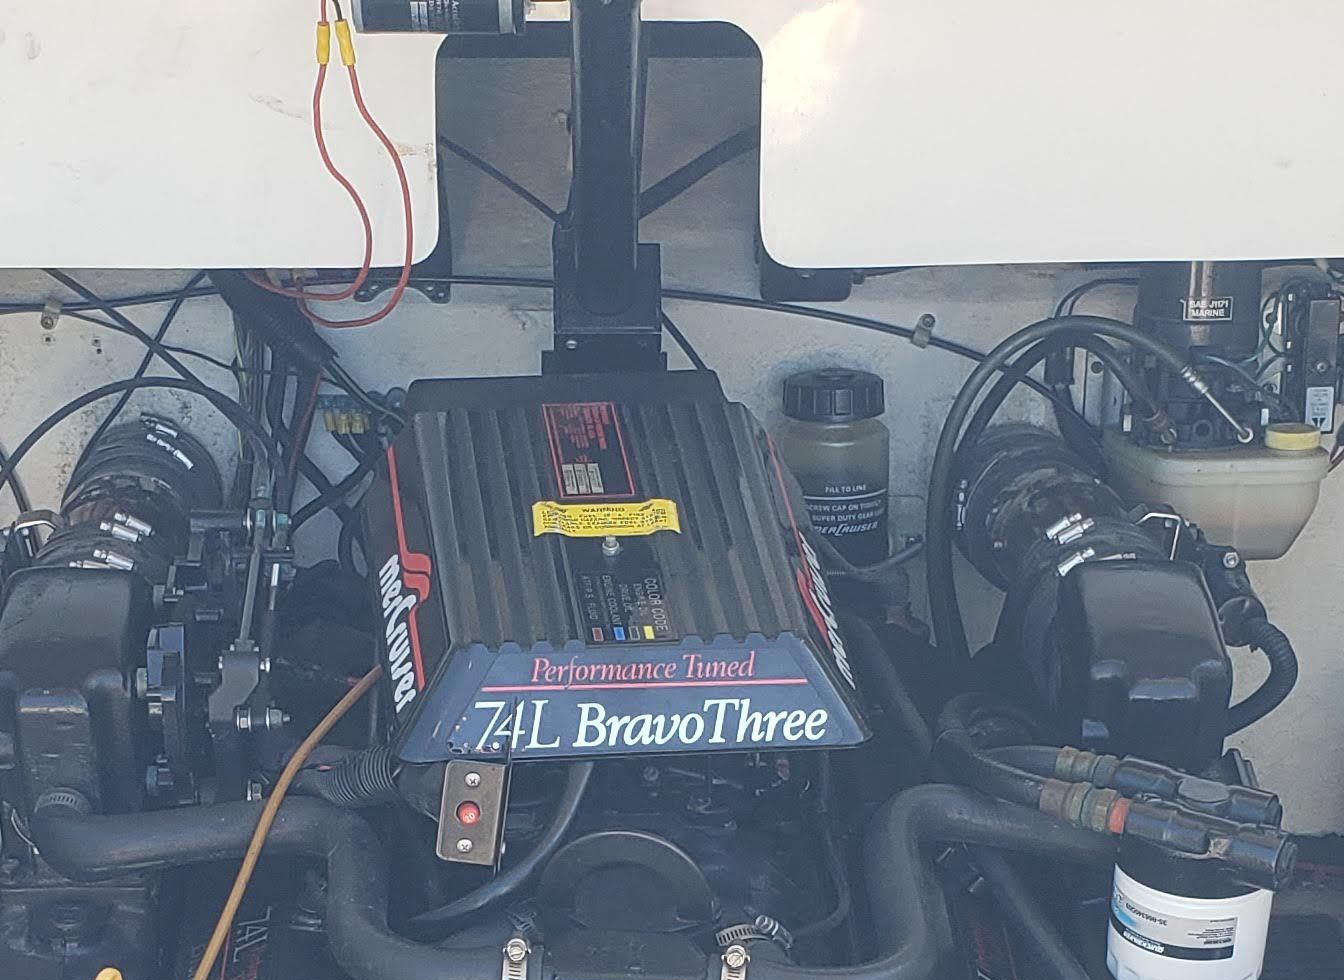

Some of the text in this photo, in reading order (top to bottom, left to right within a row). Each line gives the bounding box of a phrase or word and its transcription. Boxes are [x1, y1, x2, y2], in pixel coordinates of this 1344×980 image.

[1191, 308, 1225, 317] MARINE
[825, 486, 840, 494] FILL
[852, 484, 867, 492] LINE
[831, 504, 847, 512] CAP
[848, 503, 859, 511] ON
[837, 514, 857, 522] DUTY
[644, 577, 669, 631] COLOR CODE
[531, 651, 756, 685] Performance Tuned
